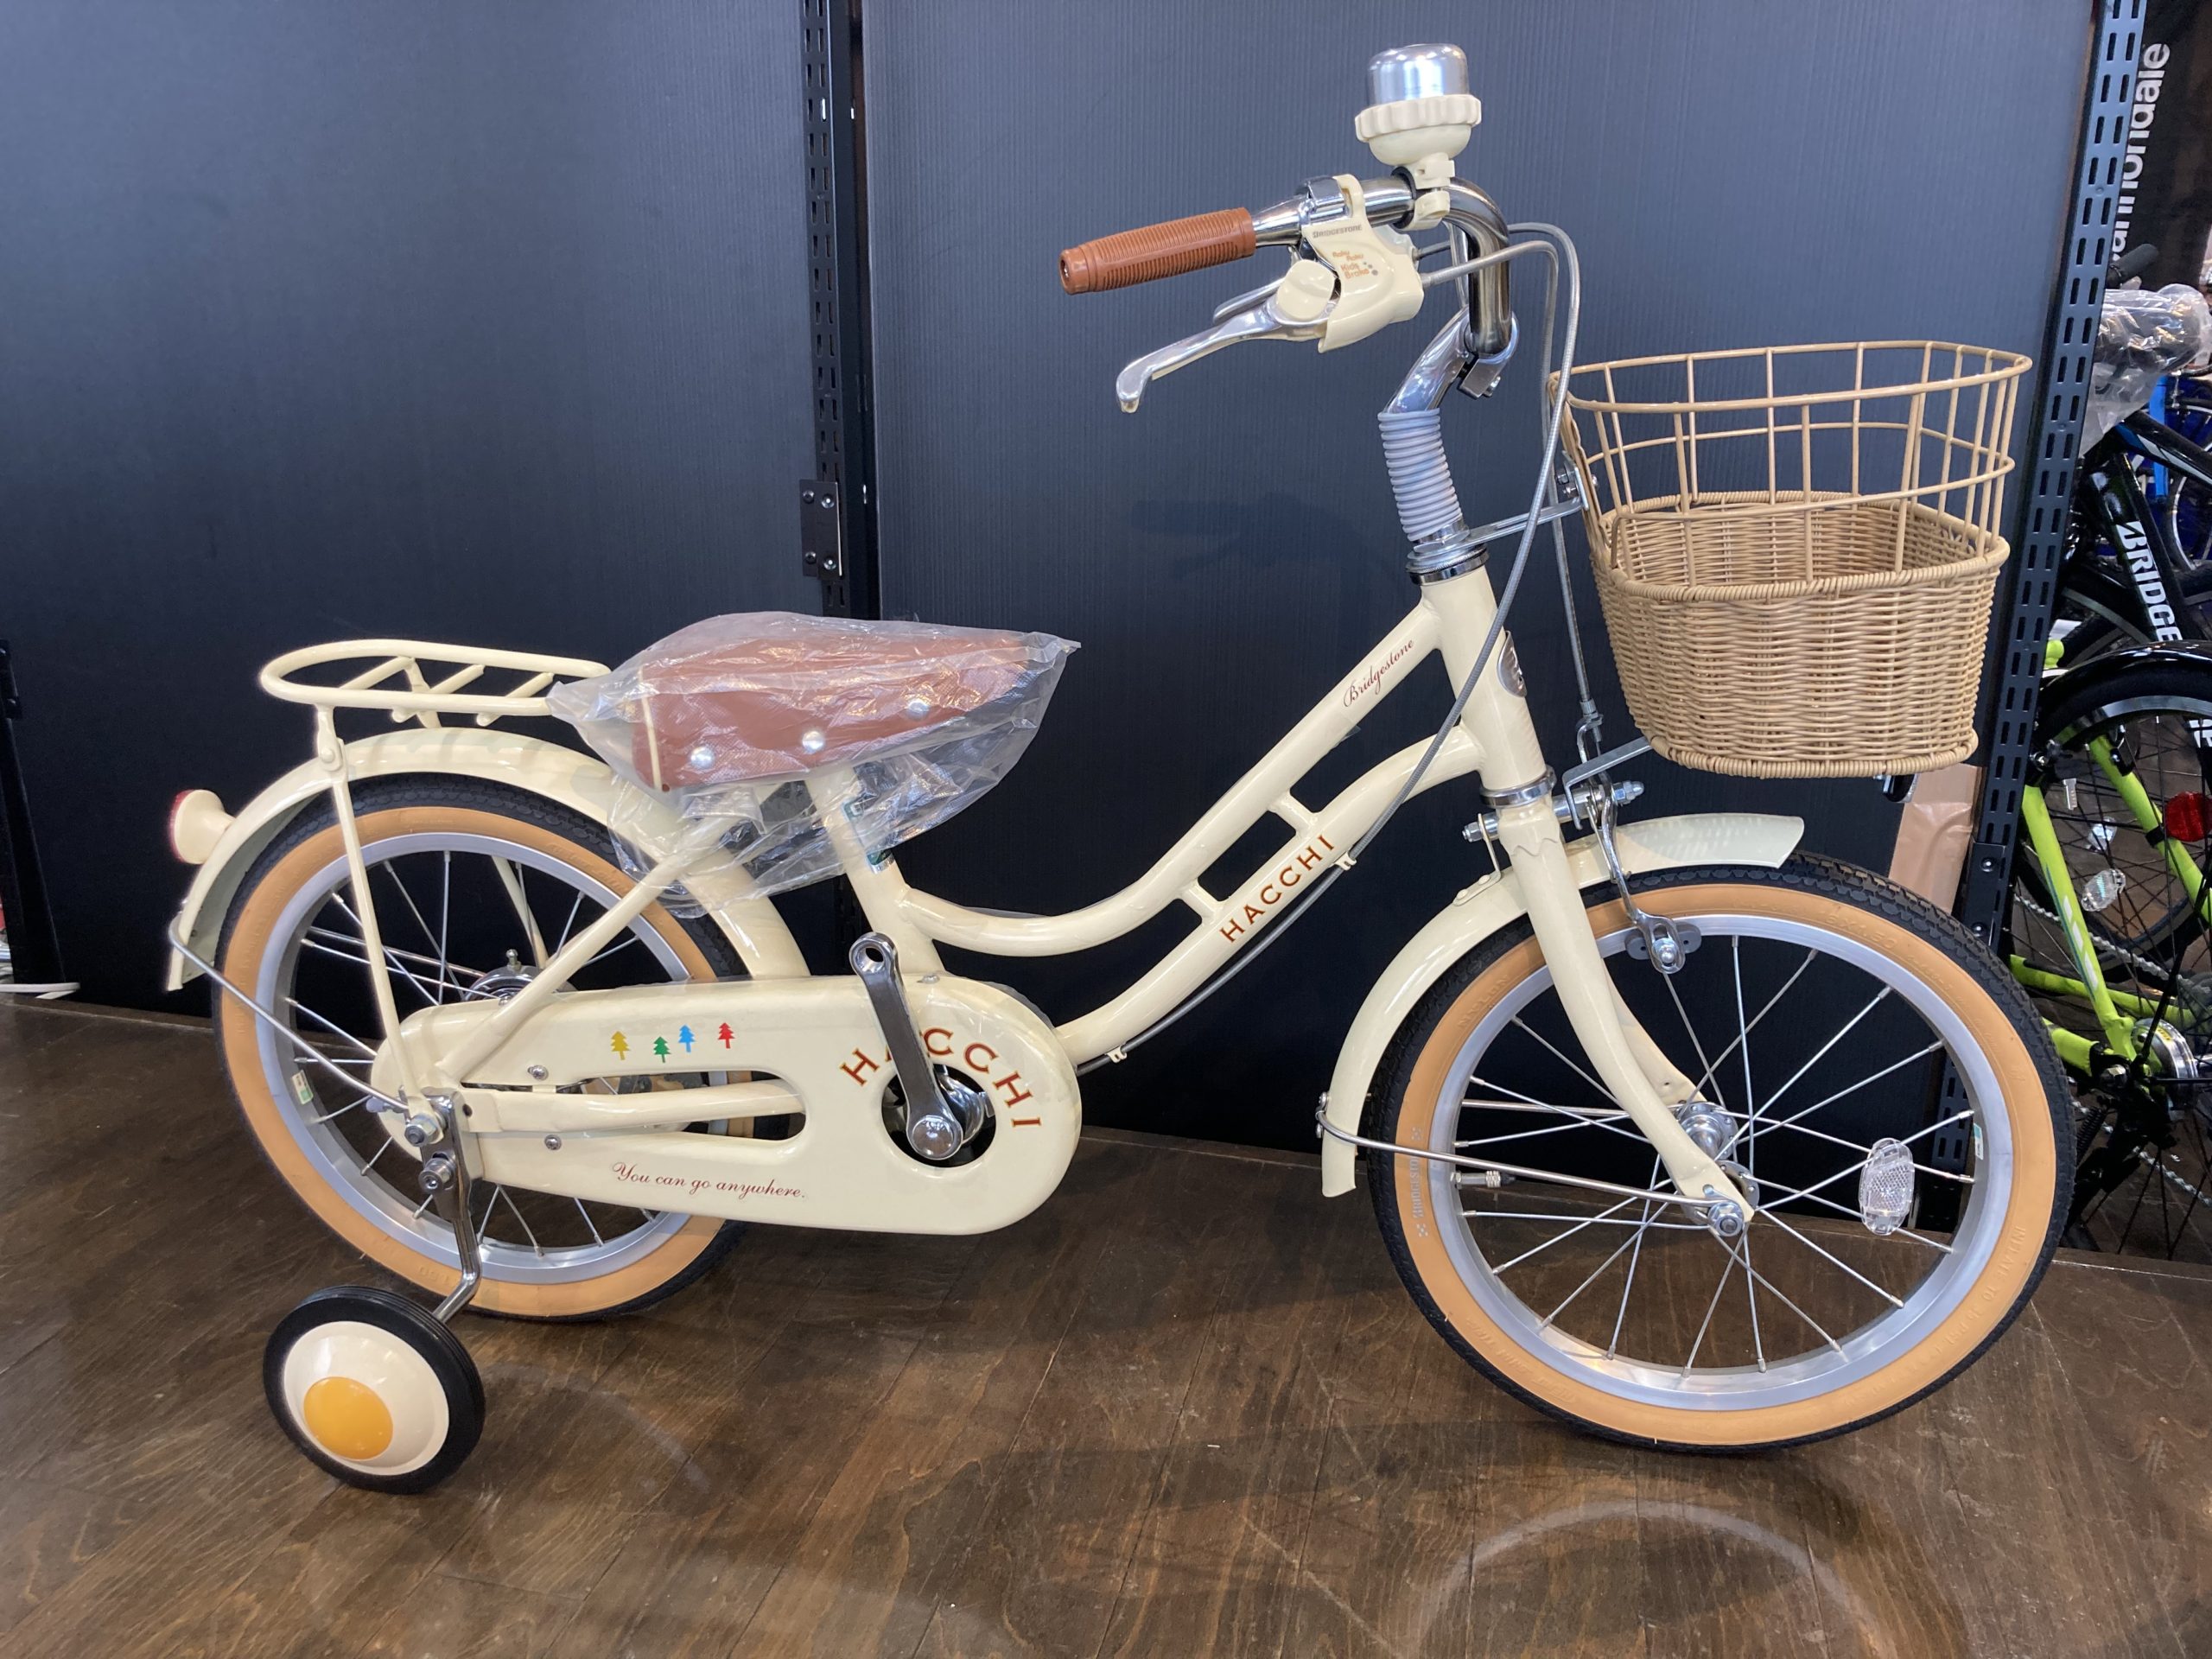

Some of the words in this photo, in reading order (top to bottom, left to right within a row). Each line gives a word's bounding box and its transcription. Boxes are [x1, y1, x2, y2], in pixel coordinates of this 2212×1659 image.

[1343, 639, 1414, 708] Bridgestone
[1219, 834, 1335, 943] HACCHI
[839, 1027, 1042, 1128] HCCHI
[612, 1161, 650, 1184] You
[655, 1175, 686, 1186] can
[689, 1179, 711, 1195] go
[716, 1179, 806, 1200] anywhere.
